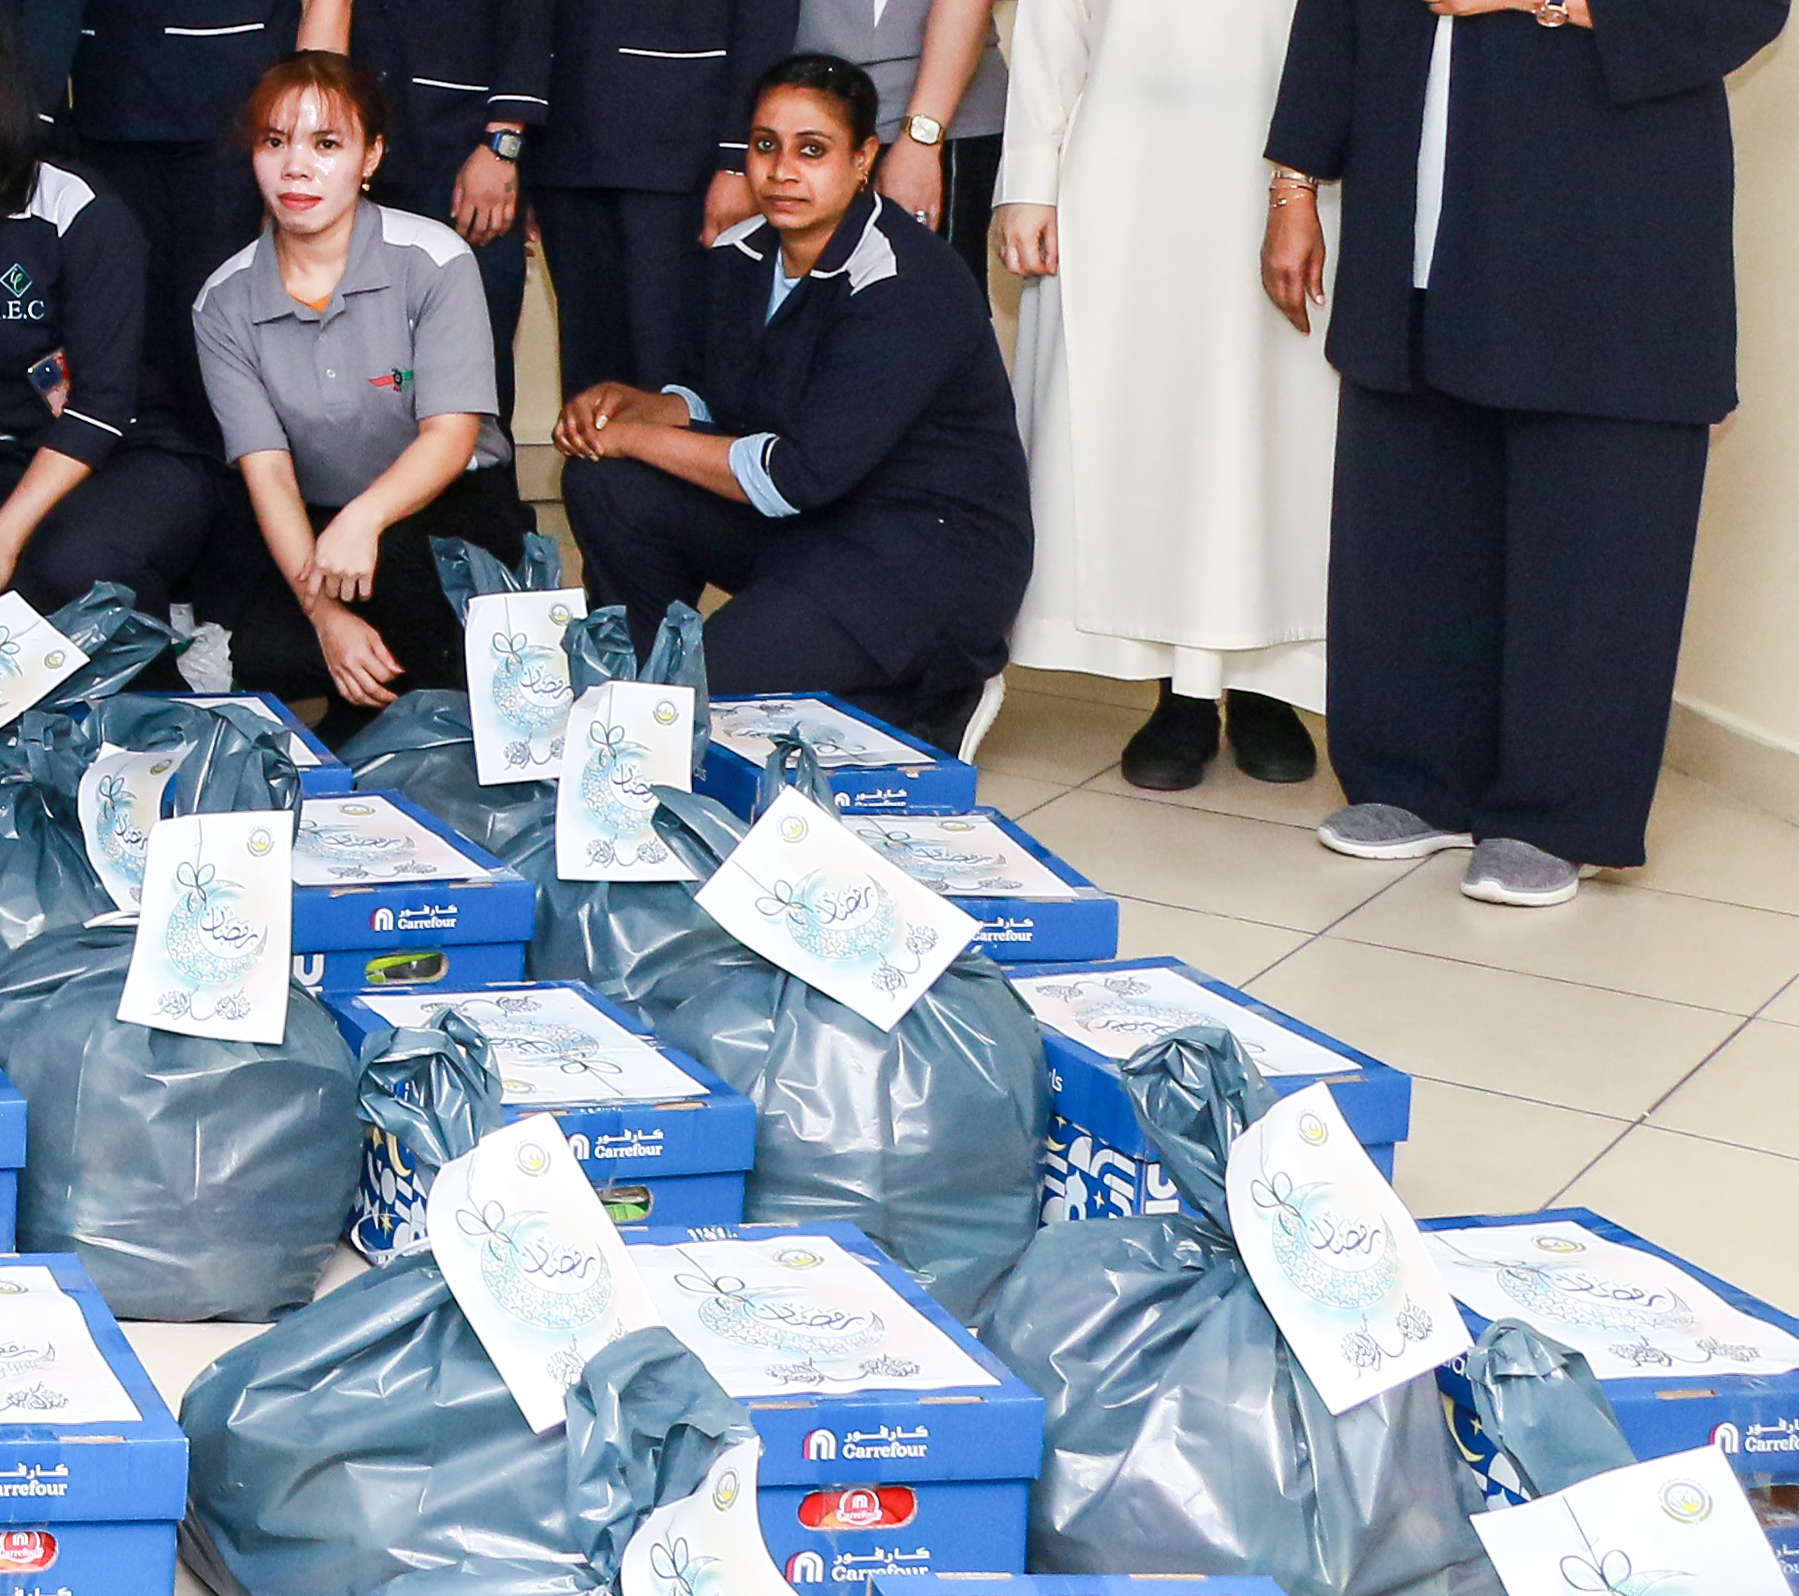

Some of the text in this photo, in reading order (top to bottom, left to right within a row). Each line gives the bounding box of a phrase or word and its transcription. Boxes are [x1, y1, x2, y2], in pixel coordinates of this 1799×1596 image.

[397, 916, 457, 930] Carrefour
[596, 1129, 664, 1144] كارفور
[594, 1144, 663, 1159] Carrefour
[844, 1425, 929, 1443] كارفور
[842, 1442, 928, 1459] Carrefour
[834, 1547, 930, 1564] كارفور
